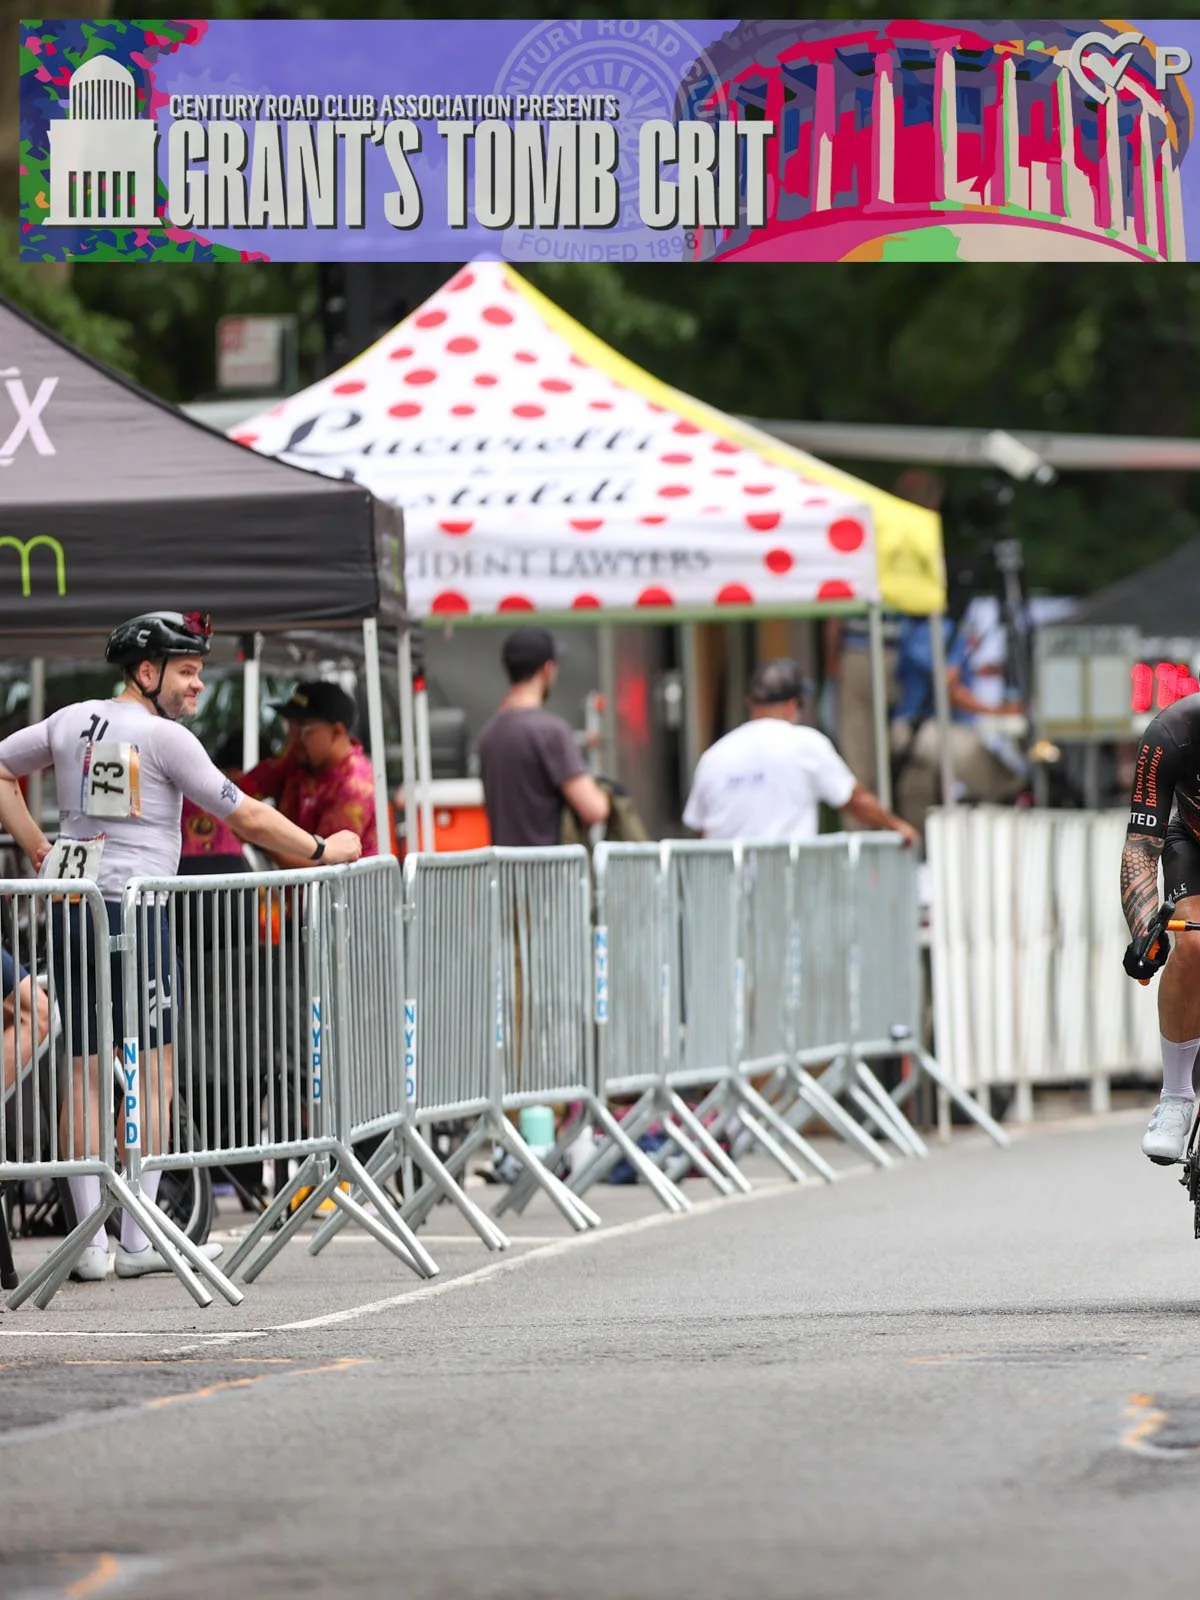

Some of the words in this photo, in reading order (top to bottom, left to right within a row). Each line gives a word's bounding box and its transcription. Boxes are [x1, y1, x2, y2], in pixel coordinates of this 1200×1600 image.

[548, 548, 713, 578] LAWYERS
[92, 761, 124, 795] 73
[1133, 744, 1150, 803] Brooklyn
[1145, 746, 1163, 808] Bathhouse
[1131, 812, 1157, 827] TED
[58, 845, 87, 879] 73
[312, 1006, 321, 1099] NYPD
[404, 1006, 415, 1097] NYPD
[124, 1042, 138, 1144] NYPD
